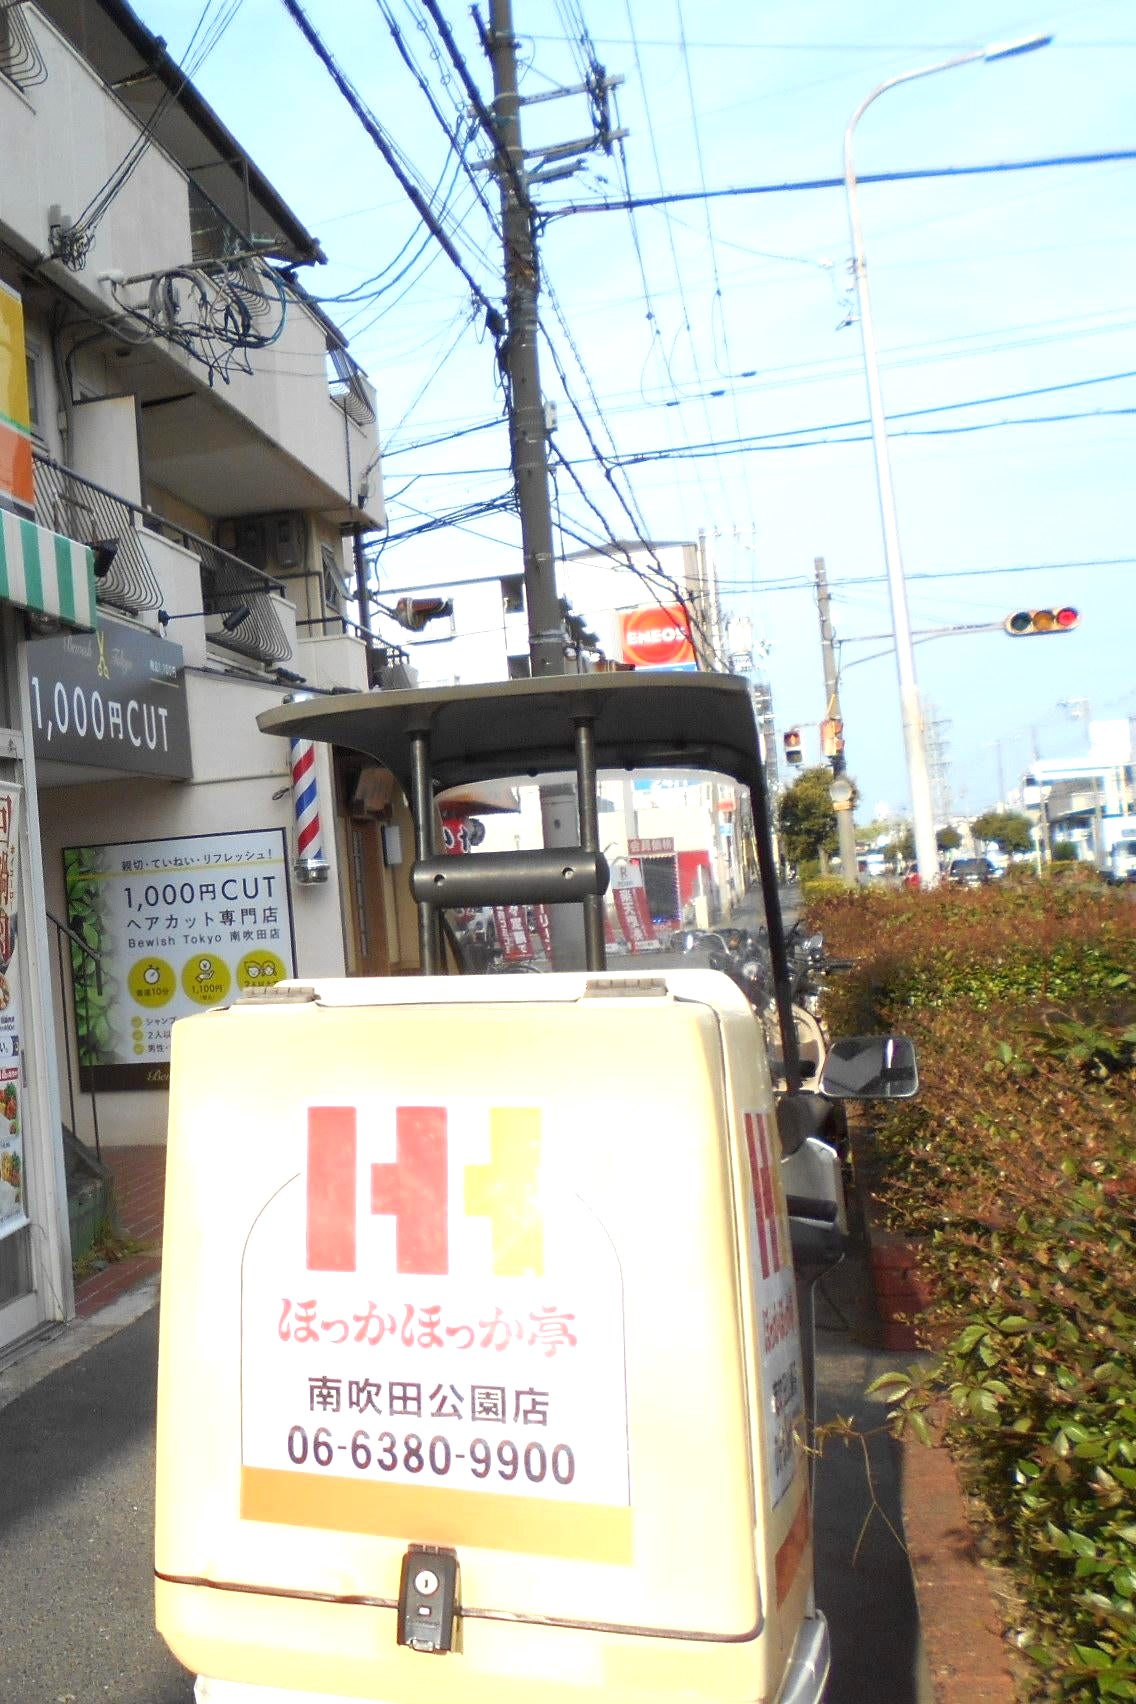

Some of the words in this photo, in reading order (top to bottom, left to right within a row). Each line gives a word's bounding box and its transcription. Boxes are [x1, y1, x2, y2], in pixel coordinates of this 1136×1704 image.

[31, 675, 169, 752] 1,000円CUT
[124, 875, 276, 912] 1,000円CUT
[127, 906, 279, 931] ヘアカット専門店
[128, 934, 176, 949] Bewish
[184, 932, 222, 945] Tokyo
[230, 928, 281, 943] 南吹田店
[192, 984, 224, 994] 1,100円
[278, 1297, 578, 1358] ほっかほっか亭
[308, 1375, 550, 1427] 南吹田公園店
[287, 1424, 576, 1485] 06-6380-9900
